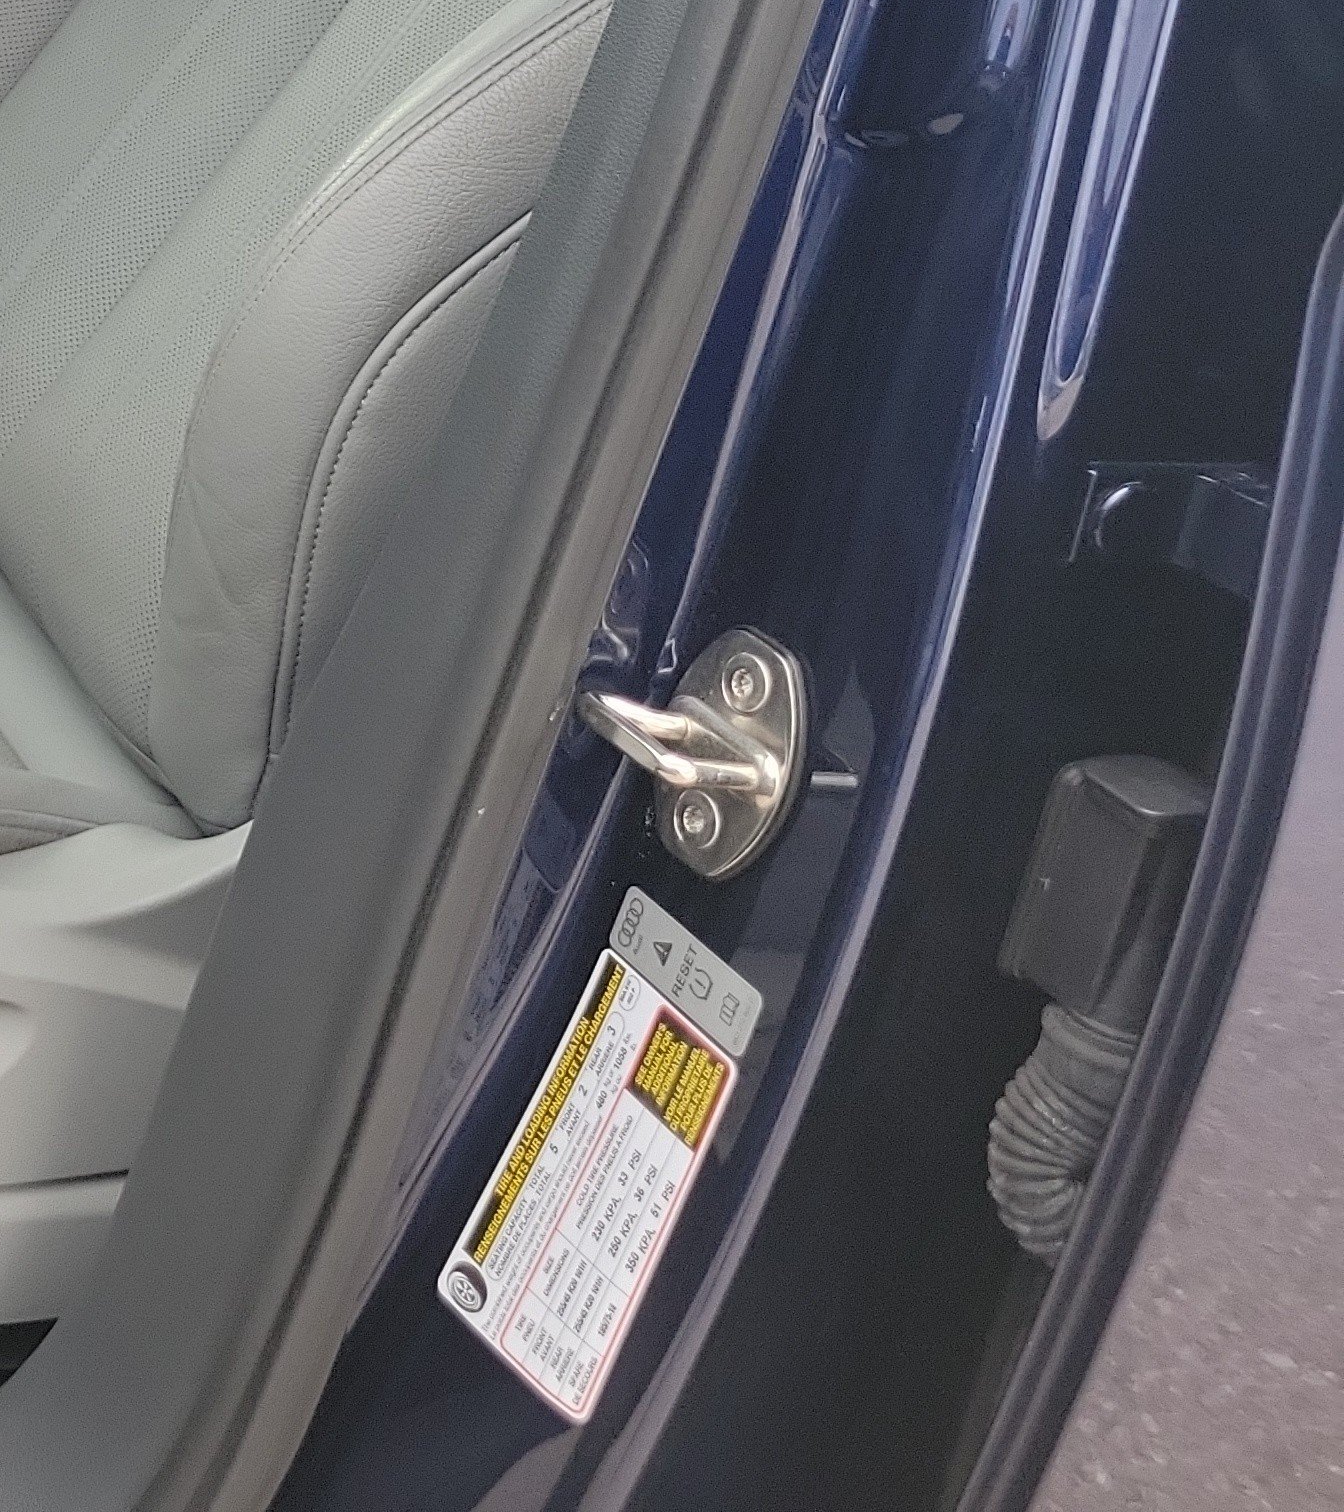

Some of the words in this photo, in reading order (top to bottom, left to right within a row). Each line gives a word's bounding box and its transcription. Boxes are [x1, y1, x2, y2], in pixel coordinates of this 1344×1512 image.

[670, 942, 698, 998] RESET
[606, 1024, 616, 1036] 3
[587, 1046, 602, 1070] REAR
[612, 1046, 627, 1070] 1058
[633, 1064, 648, 1085] SEE
[641, 1049, 664, 1091] MANUAL
[658, 1028, 673, 1052] FOR
[648, 1038, 679, 1095] ADDITIONAL
[654, 1040, 688, 1105] INFORMATION
[678, 1044, 701, 1086] MANUEL
[494, 1168, 513, 1198] TIRE
[507, 1142, 526, 1172] AND
[520, 1092, 551, 1147] LOADING
[546, 1015, 590, 1096] INFORMATION
[577, 1083, 588, 1096] 2
[594, 1089, 608, 1109] 480
[662, 1096, 678, 1122] VOIR
[673, 1083, 684, 1099] LE
[679, 1100, 697, 1131] POUR
[691, 1075, 708, 1104] PLUS
[702, 1062, 713, 1079] DE
[683, 1060, 725, 1145] RENSEIGNEMENTS
[472, 1160, 529, 1263] RENSEIGNEMENTS
[523, 1136, 541, 1164] SUR
[537, 1113, 553, 1139] LES
[548, 1075, 572, 1117] PNEUS
[567, 1059, 580, 1078] ET
[575, 1043, 588, 1062] LE
[582, 963, 624, 1046] CHARGEMENT
[558, 1102, 575, 1130] FRONT
[565, 1108, 581, 1136] AVANT
[669, 1114, 680, 1132] DU
[548, 1141, 559, 1155] 5
[575, 1182, 590, 1207] COLD
[595, 1122, 618, 1166] PRESSURE
[616, 1169, 628, 1187] 33
[627, 1148, 641, 1170] PSI
[528, 1162, 544, 1190] TOTAL
[535, 1169, 551, 1196] TOTAL
[575, 1188, 598, 1230] PRESSION
[593, 1172, 605, 1191] DES
[601, 1145, 618, 1174] PNEUS
[617, 1113, 633, 1141] FROID
[633, 1185, 645, 1202] 36
[642, 1162, 658, 1186] PSI
[590, 1218, 605, 1242] 230
[603, 1192, 621, 1223] KPA,
[649, 1201, 661, 1219] 51
[660, 1178, 675, 1202] PSI
[488, 1235, 508, 1271] SEATING
[505, 1196, 527, 1237] CAPACITY
[495, 1240, 515, 1277] NOMBRE
[512, 1229, 521, 1242] DE
[518, 1198, 536, 1231] PLACES
[607, 1234, 622, 1258] 250
[618, 1207, 637, 1239] KPA,
[624, 1249, 639, 1274] 350
[637, 1223, 656, 1255] KPA,
[542, 1246, 569, 1297] DIMENSIONS
